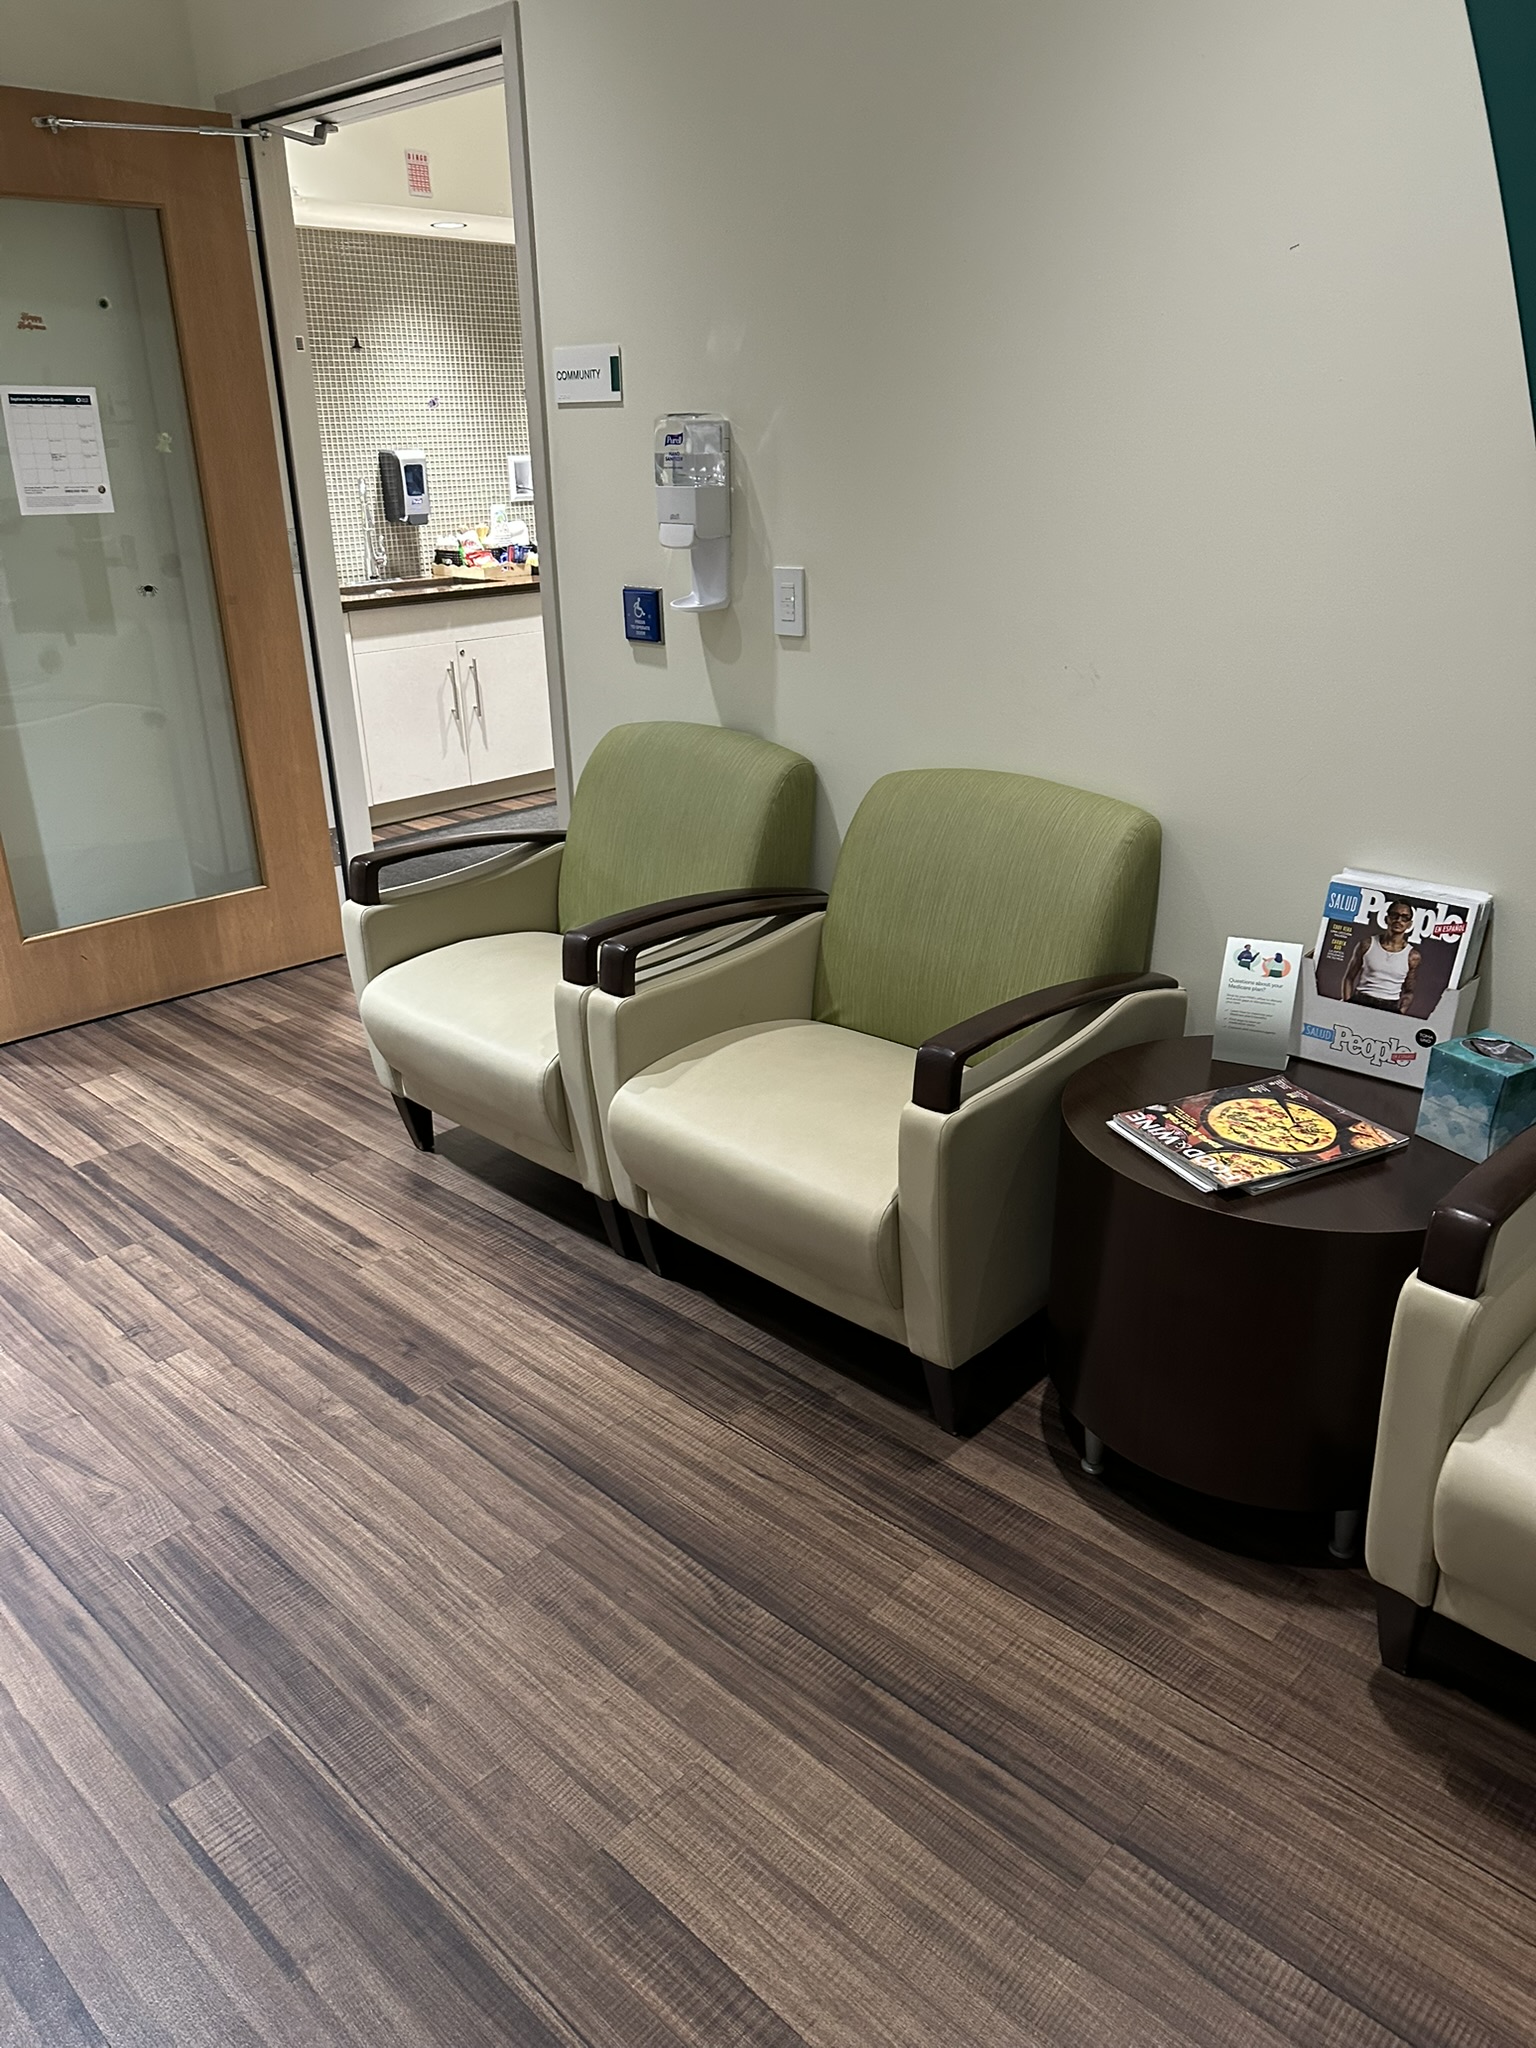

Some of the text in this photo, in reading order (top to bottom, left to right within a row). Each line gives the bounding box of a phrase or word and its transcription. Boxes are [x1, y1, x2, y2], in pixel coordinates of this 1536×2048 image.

[556, 369, 601, 381] COMMUNITY
[1328, 892, 1358, 912] SALUD
[1228, 983, 1251, 991] Medicare
[1229, 977, 1255, 986] Questions
[1255, 980, 1271, 988] about
[1304, 1025, 1332, 1040] SALUD
[1330, 1023, 1412, 1067] People
[1125, 1111, 1181, 1146] WINE
[1182, 1148, 1243, 1184] FOOD
